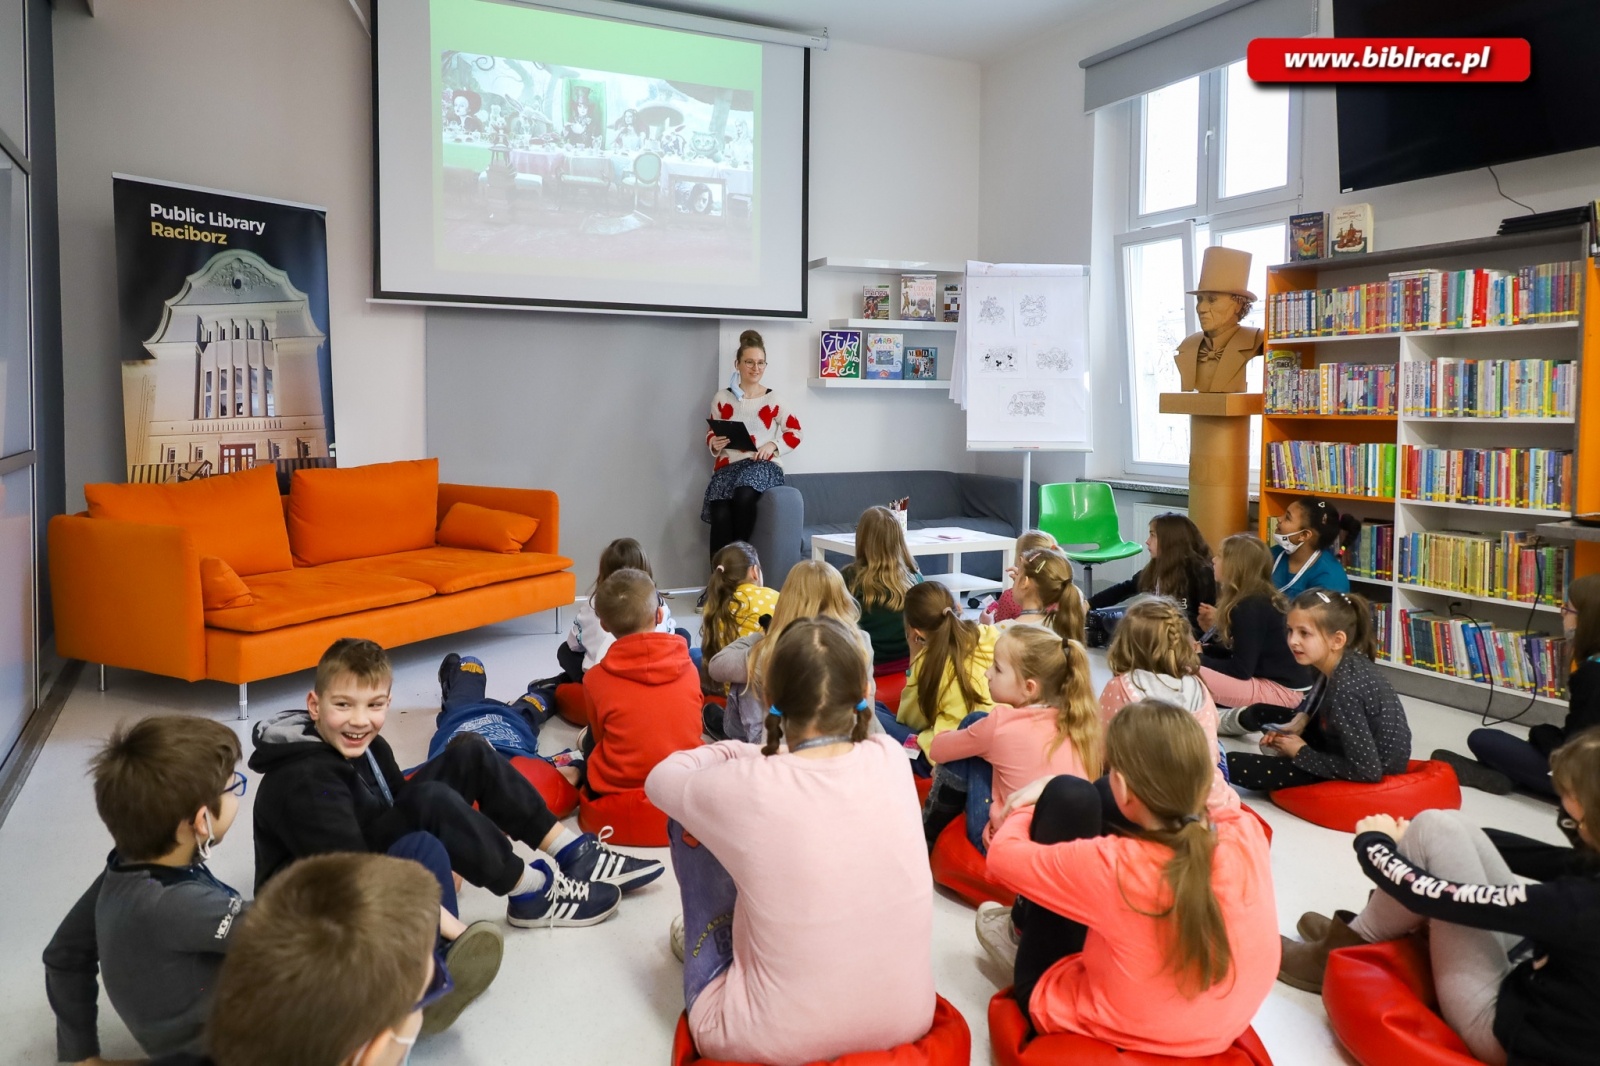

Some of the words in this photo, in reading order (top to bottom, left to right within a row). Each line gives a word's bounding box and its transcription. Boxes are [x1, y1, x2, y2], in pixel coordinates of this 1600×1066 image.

[150, 203, 206, 225] Public
[209, 211, 266, 235] Library
[151, 221, 228, 245] Raciborz
[821, 333, 860, 360] Sztuka
[908, 349, 936, 357] MODA
[821, 358, 857, 377] dzieci
[1410, 874, 1449, 899] OR
[1452, 883, 1528, 907] MEOW
